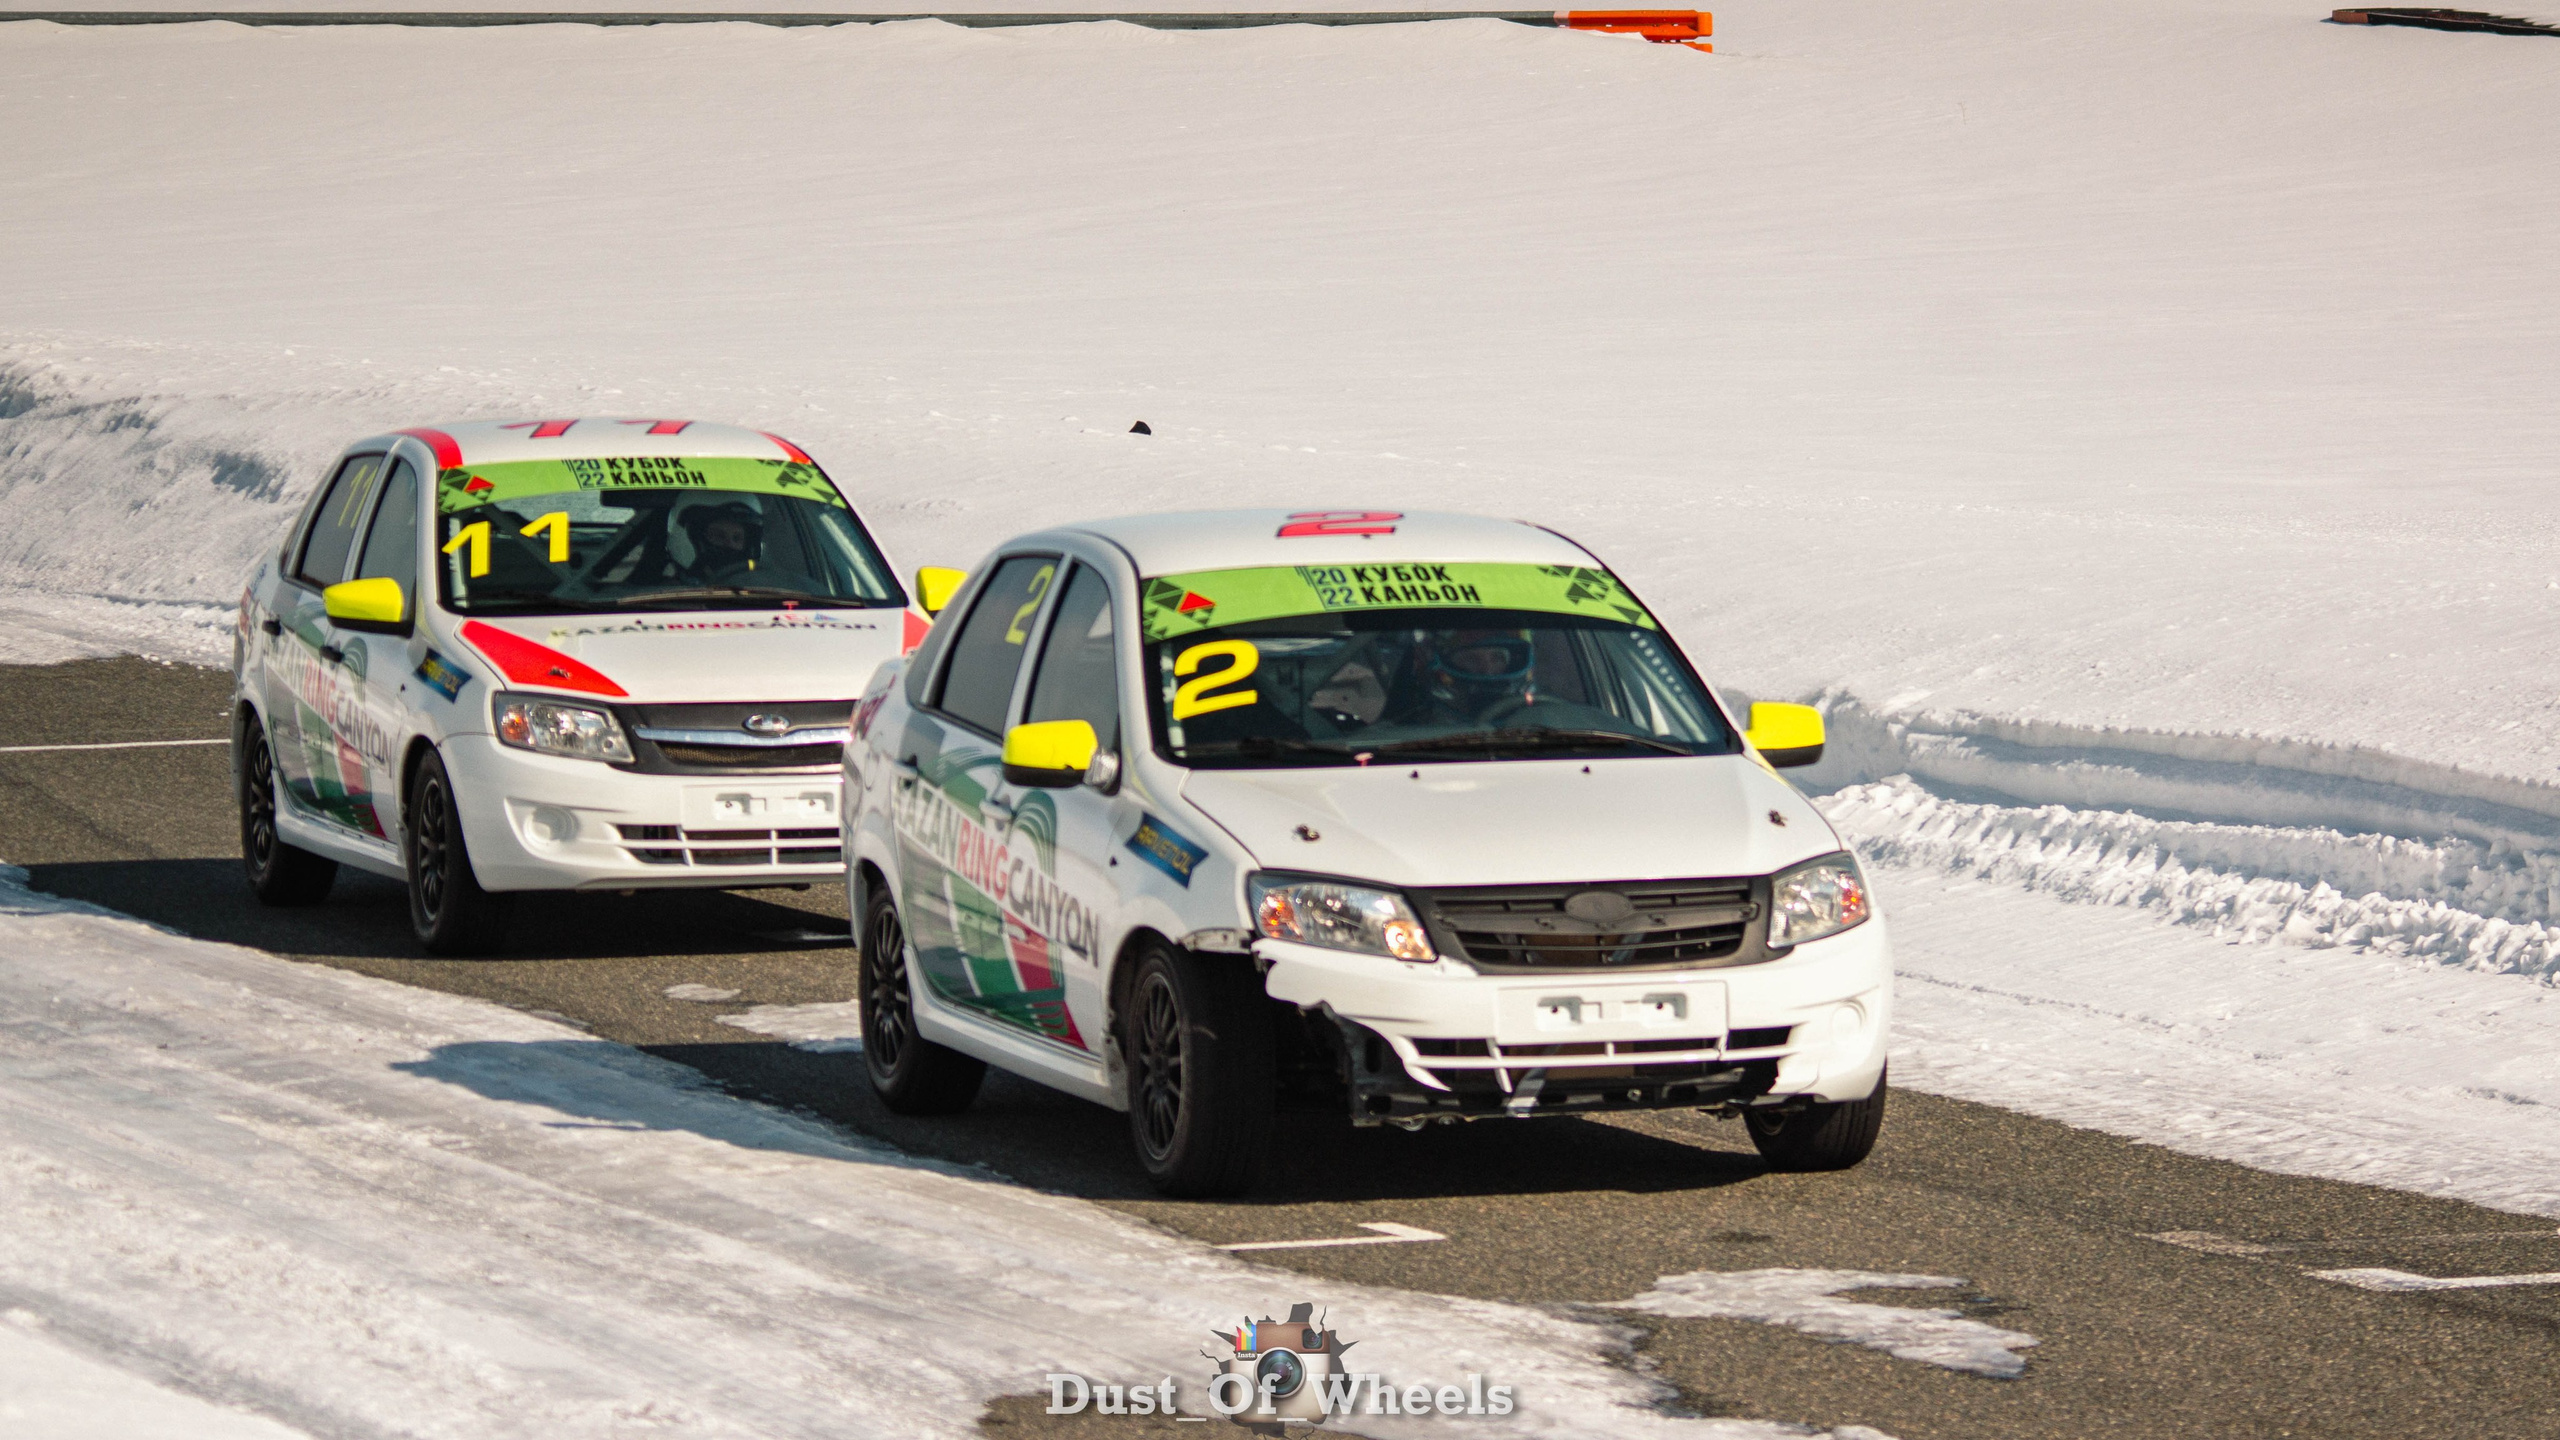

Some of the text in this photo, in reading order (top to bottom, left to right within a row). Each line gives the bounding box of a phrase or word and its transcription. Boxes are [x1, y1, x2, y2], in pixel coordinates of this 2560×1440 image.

[573, 456, 685, 471] 20 КУБОК
[579, 470, 708, 487] 22 КАНЬОН
[338, 464, 379, 529] 11
[1276, 511, 1404, 538] 2
[1312, 565, 1452, 585] 20 КУБОК
[1004, 564, 1055, 646] 2
[1322, 584, 1482, 606] 22 КАНЬОН
[1173, 639, 1259, 720] 2
